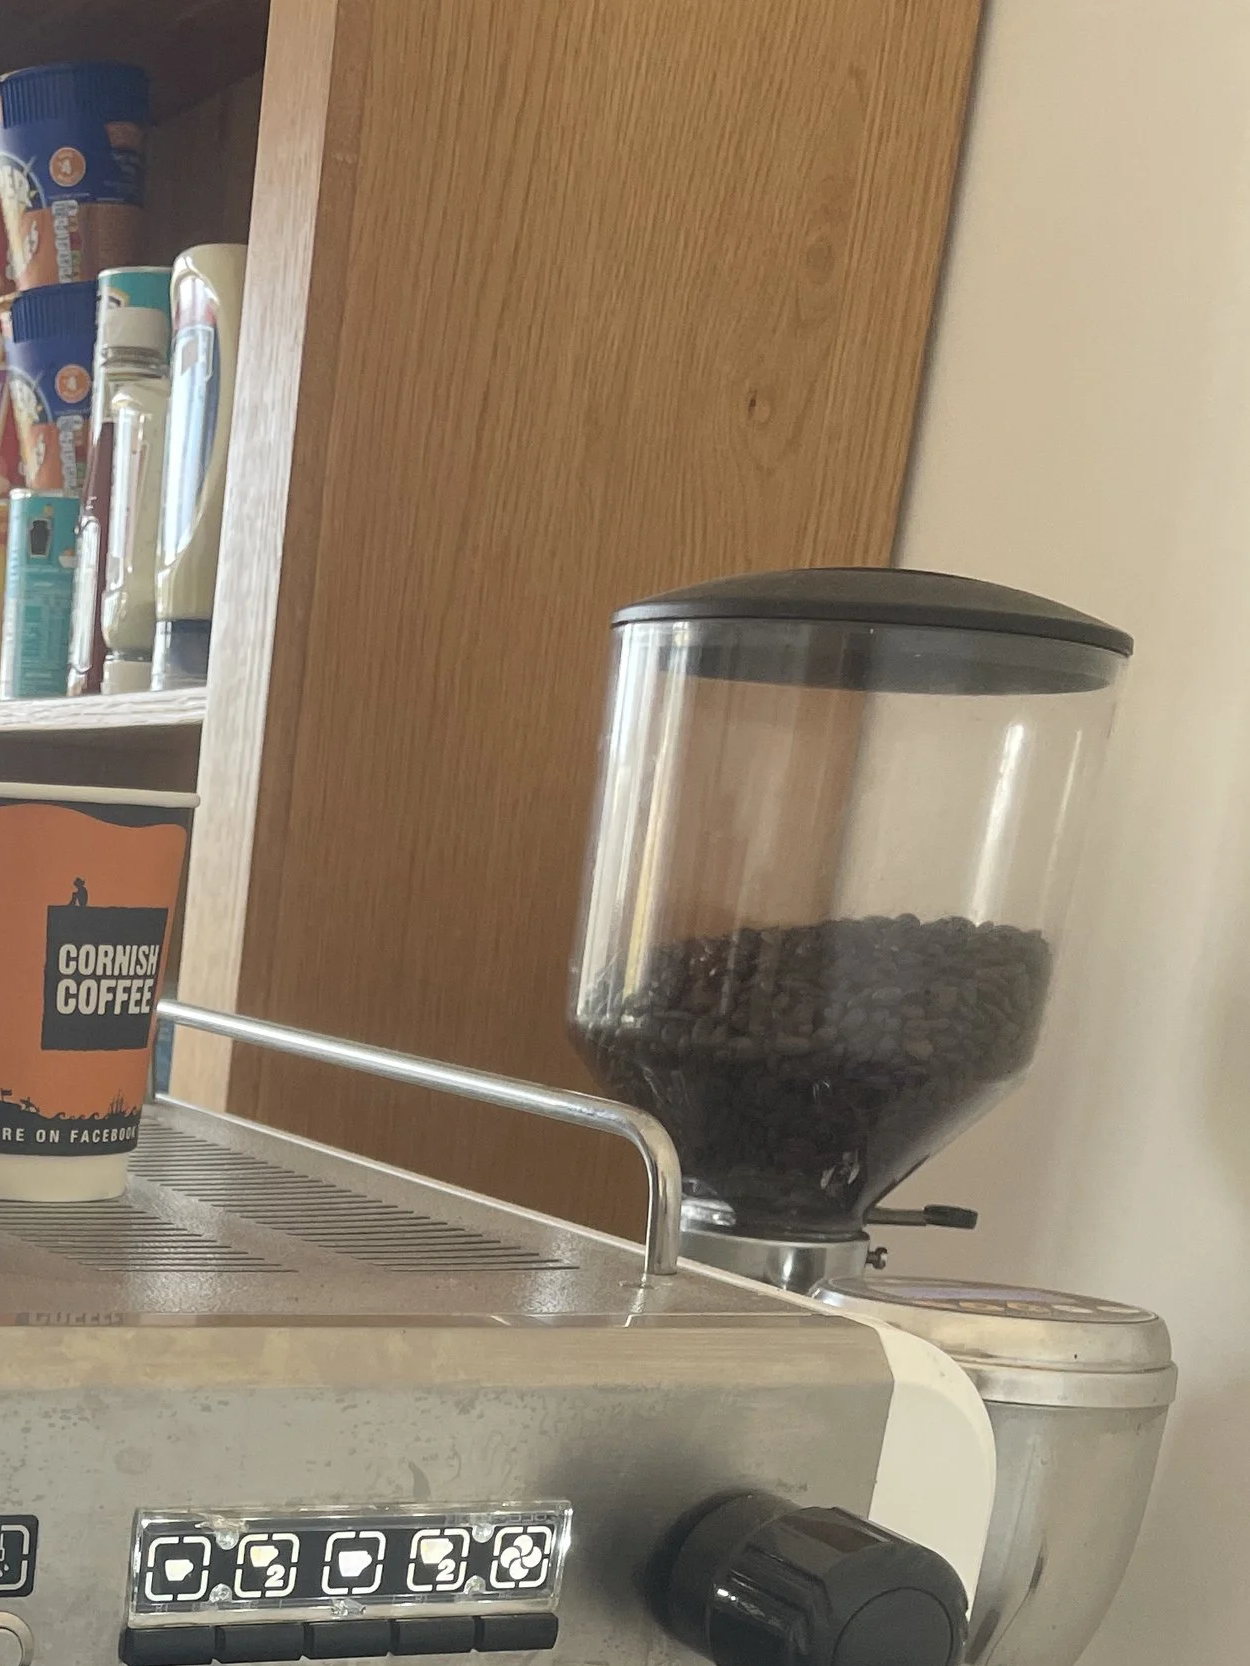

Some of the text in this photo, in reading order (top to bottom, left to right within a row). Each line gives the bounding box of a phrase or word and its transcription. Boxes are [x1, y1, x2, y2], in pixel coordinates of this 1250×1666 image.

[58, 943, 160, 977] CORNISH
[55, 978, 154, 1015] COFFEE
[36, 1129, 60, 1143] ON
[70, 1125, 139, 1144] FACEBOOK
[265, 1564, 286, 1587] 2
[435, 1558, 456, 1581] 2
